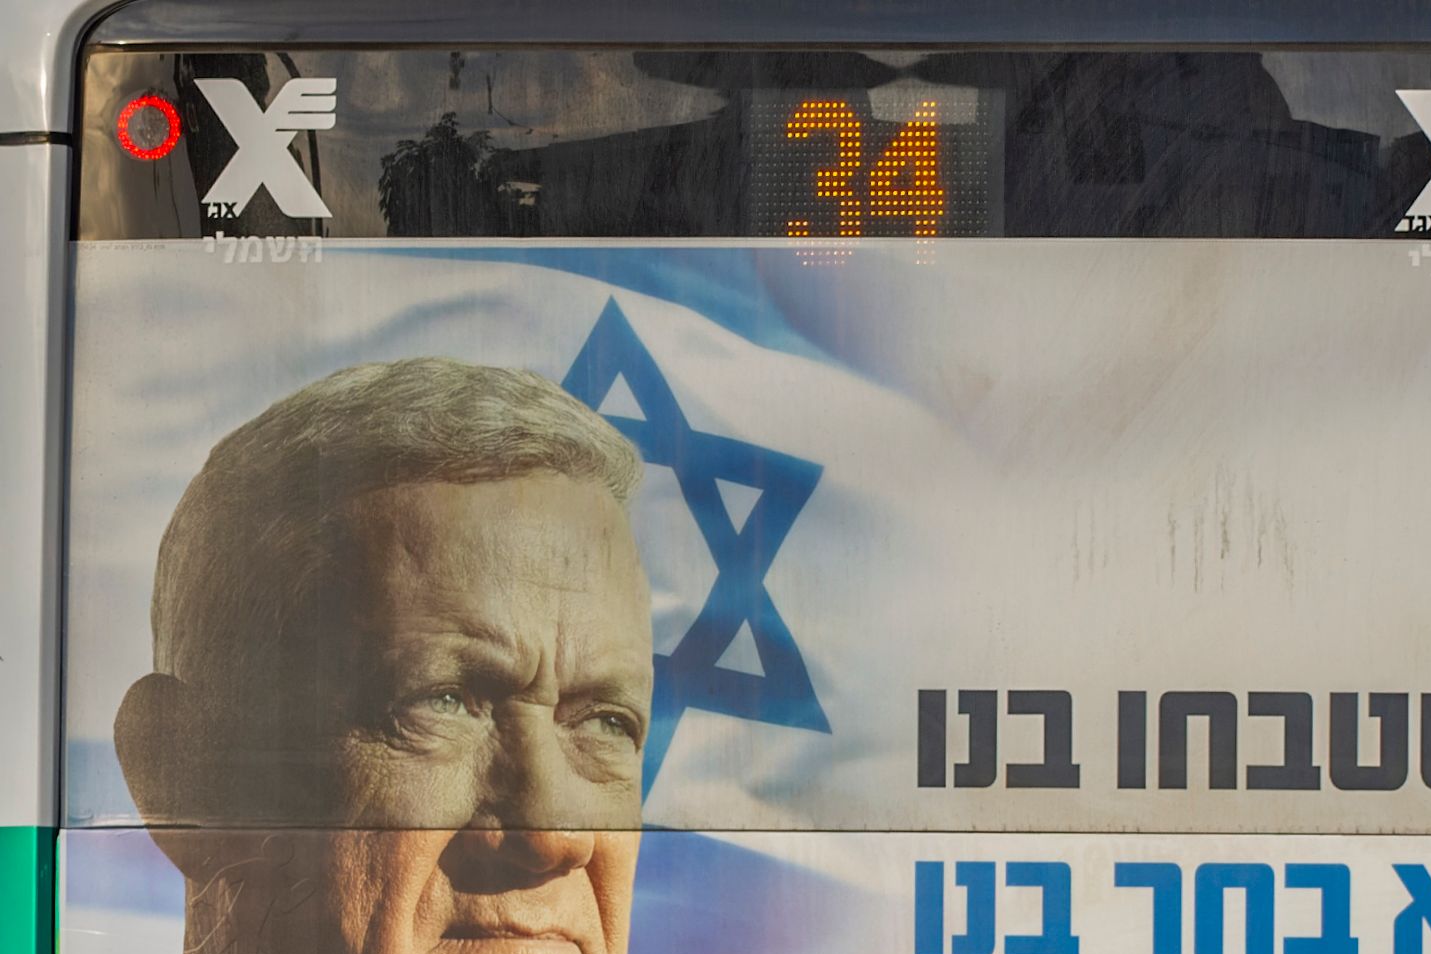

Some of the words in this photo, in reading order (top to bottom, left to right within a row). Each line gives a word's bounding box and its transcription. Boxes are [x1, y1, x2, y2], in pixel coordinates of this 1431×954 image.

[201, 201, 236, 219] אגד
[787, 101, 944, 264] 34
[202, 230, 323, 264] חשמלי
[916, 688, 1081, 789] בנו
